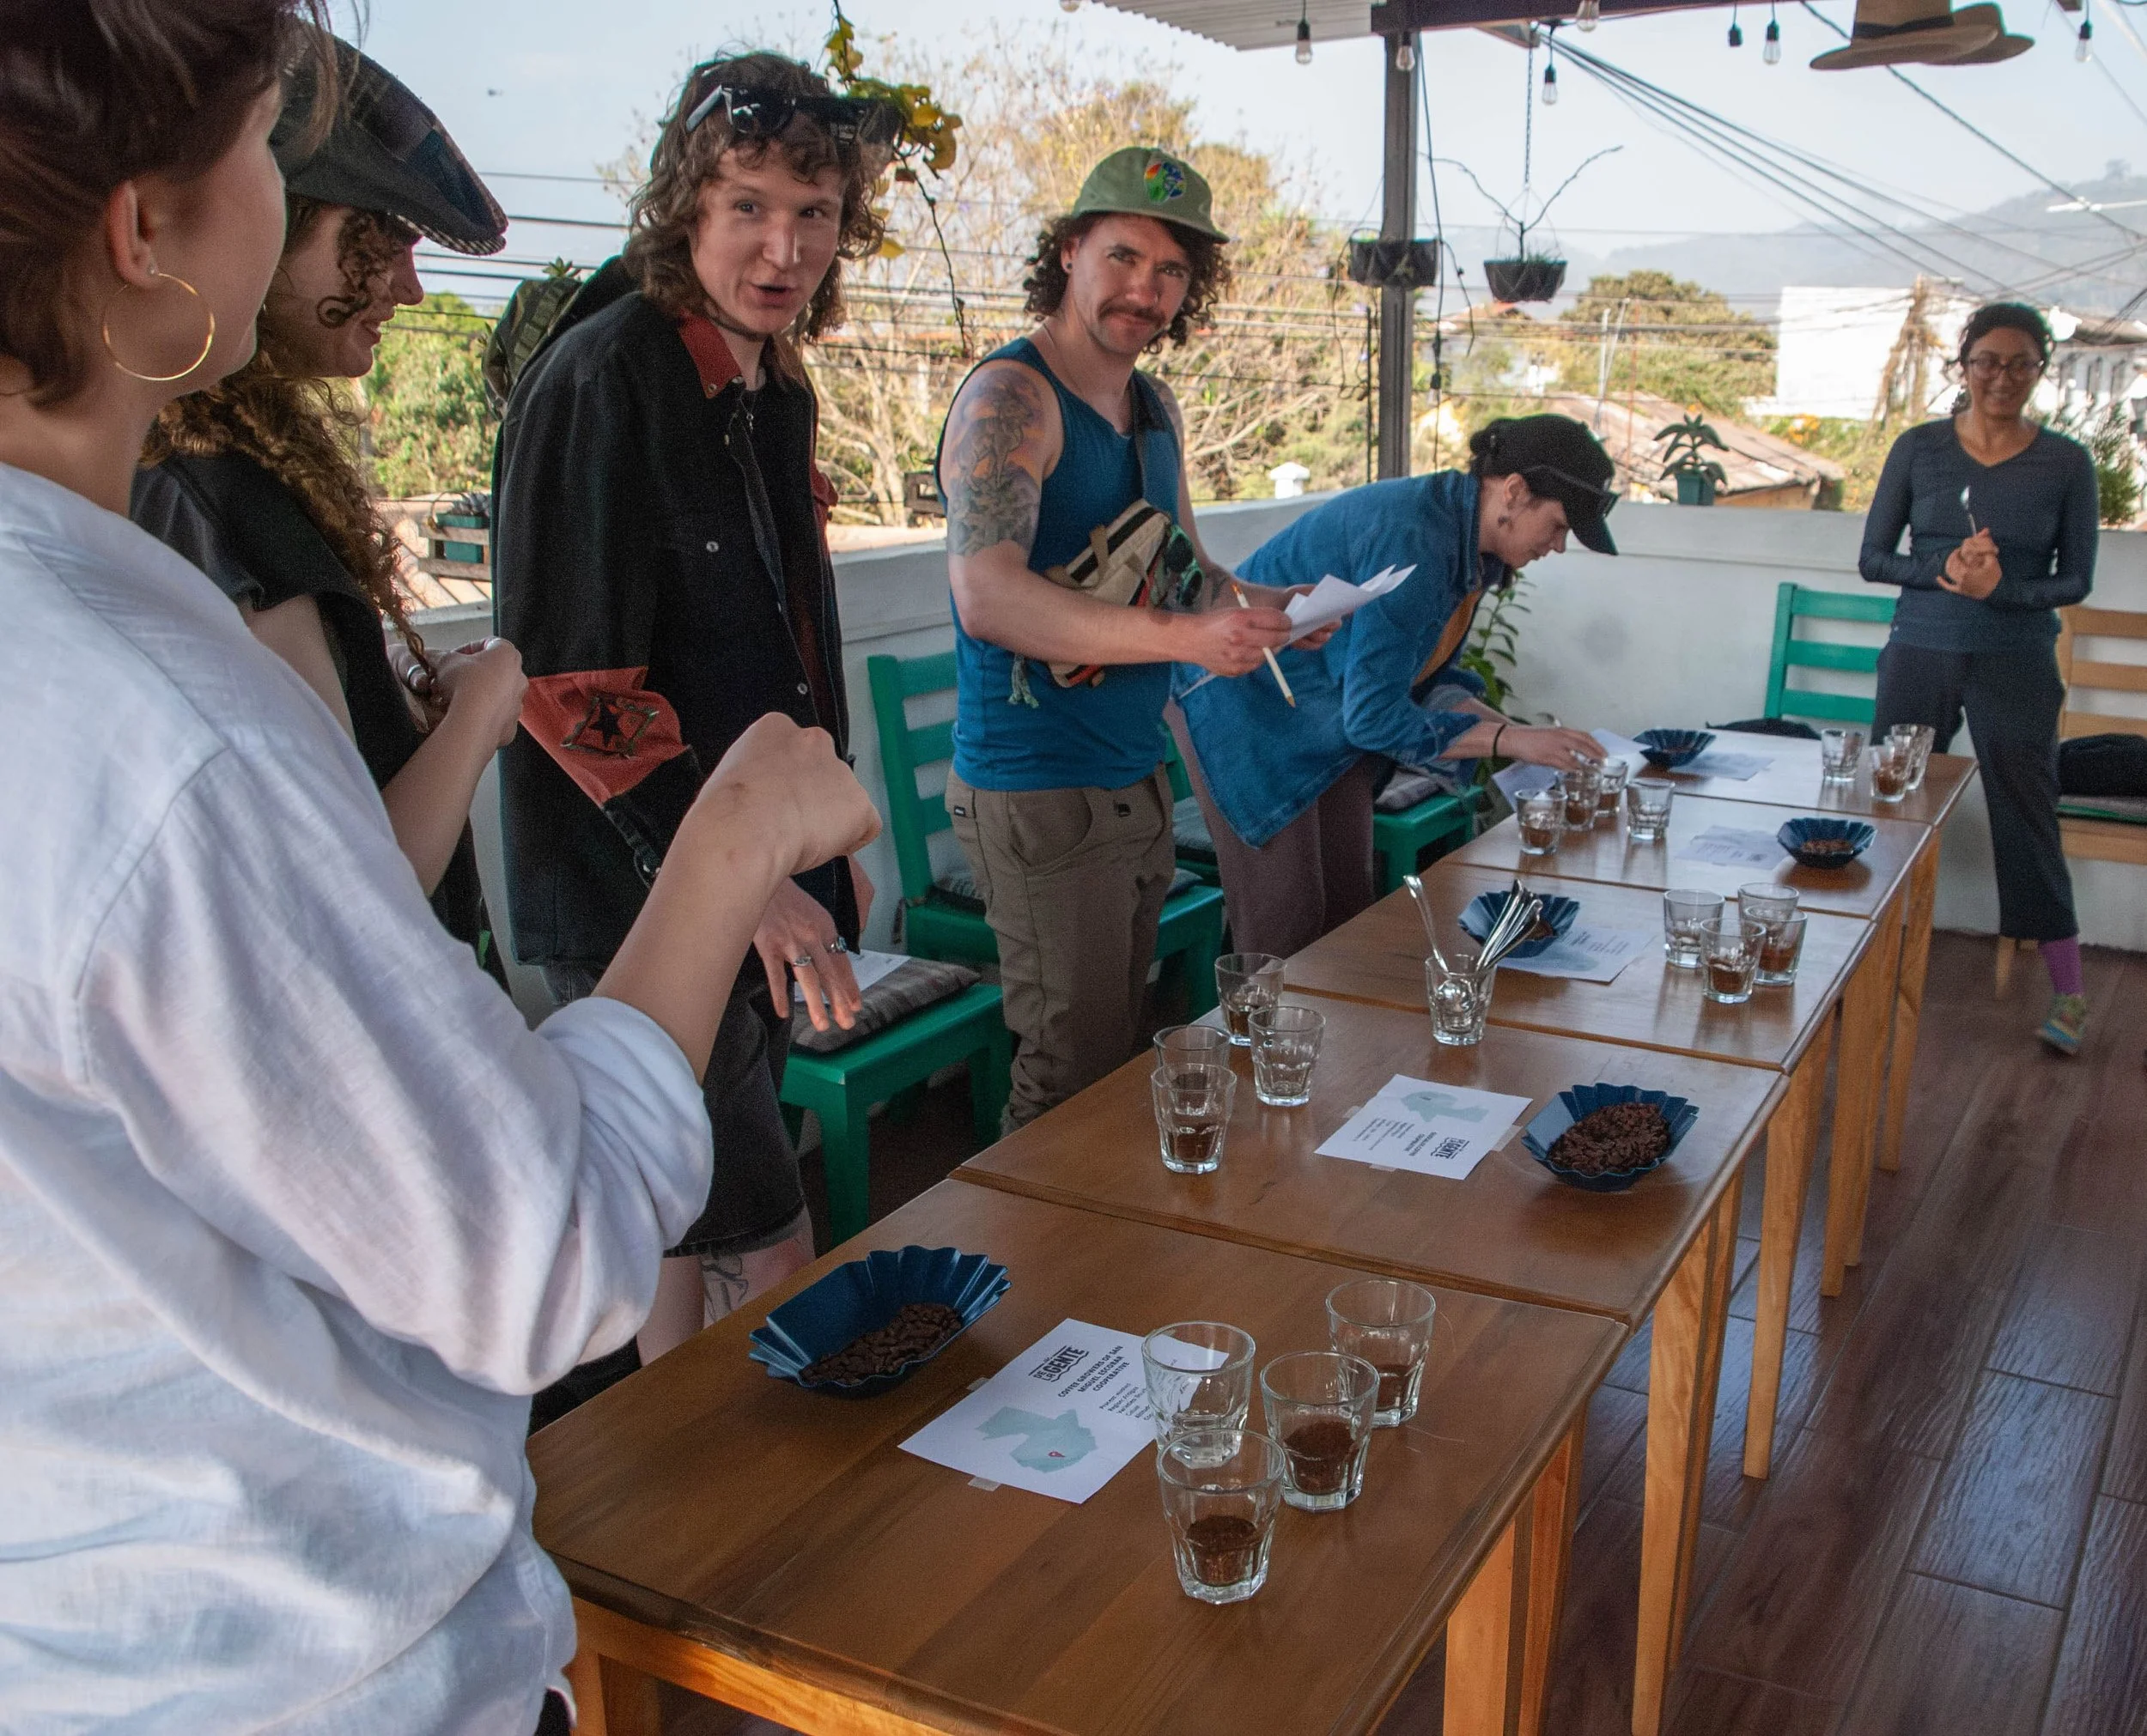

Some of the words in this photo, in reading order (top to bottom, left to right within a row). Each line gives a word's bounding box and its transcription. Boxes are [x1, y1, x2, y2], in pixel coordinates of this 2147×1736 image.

[1043, 1346, 1086, 1374] GENTE
[1056, 1381, 1080, 1397] COFFEE
[1075, 1360, 1105, 1381] GROWERS
[1108, 1345, 1123, 1354] SAN
[1033, 1370, 1046, 1379] DE
[1042, 1373, 1055, 1381] LA
[1077, 1375, 1101, 1392] MIGUEL
[1092, 1361, 1130, 1391] COOPERATIVE
